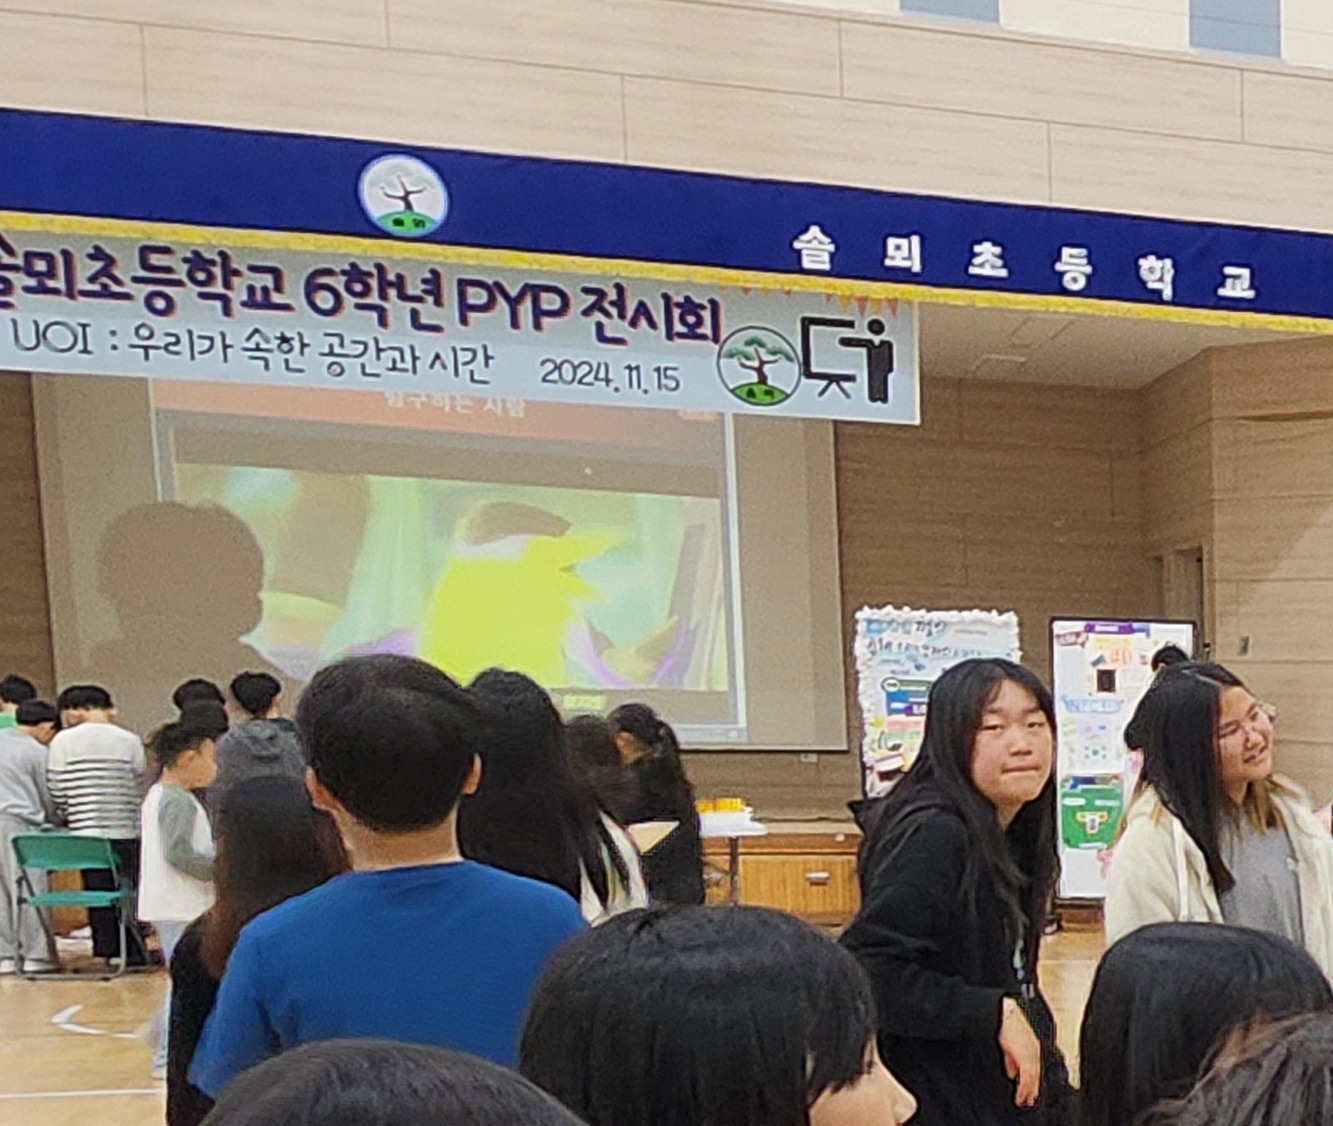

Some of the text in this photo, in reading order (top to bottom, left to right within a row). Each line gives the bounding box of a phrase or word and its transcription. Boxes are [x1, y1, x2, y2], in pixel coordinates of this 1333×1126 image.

[792, 225, 1256, 300] 솔뫼초등학교
[304, 262, 446, 333] 6학년
[457, 278, 571, 332] PYP
[580, 283, 722, 346] 전시회
[11, 318, 94, 355] UOI
[128, 322, 234, 363] 우리가
[241, 327, 311, 373] 속한
[318, 332, 420, 378] 공간과
[429, 345, 495, 385] 시간
